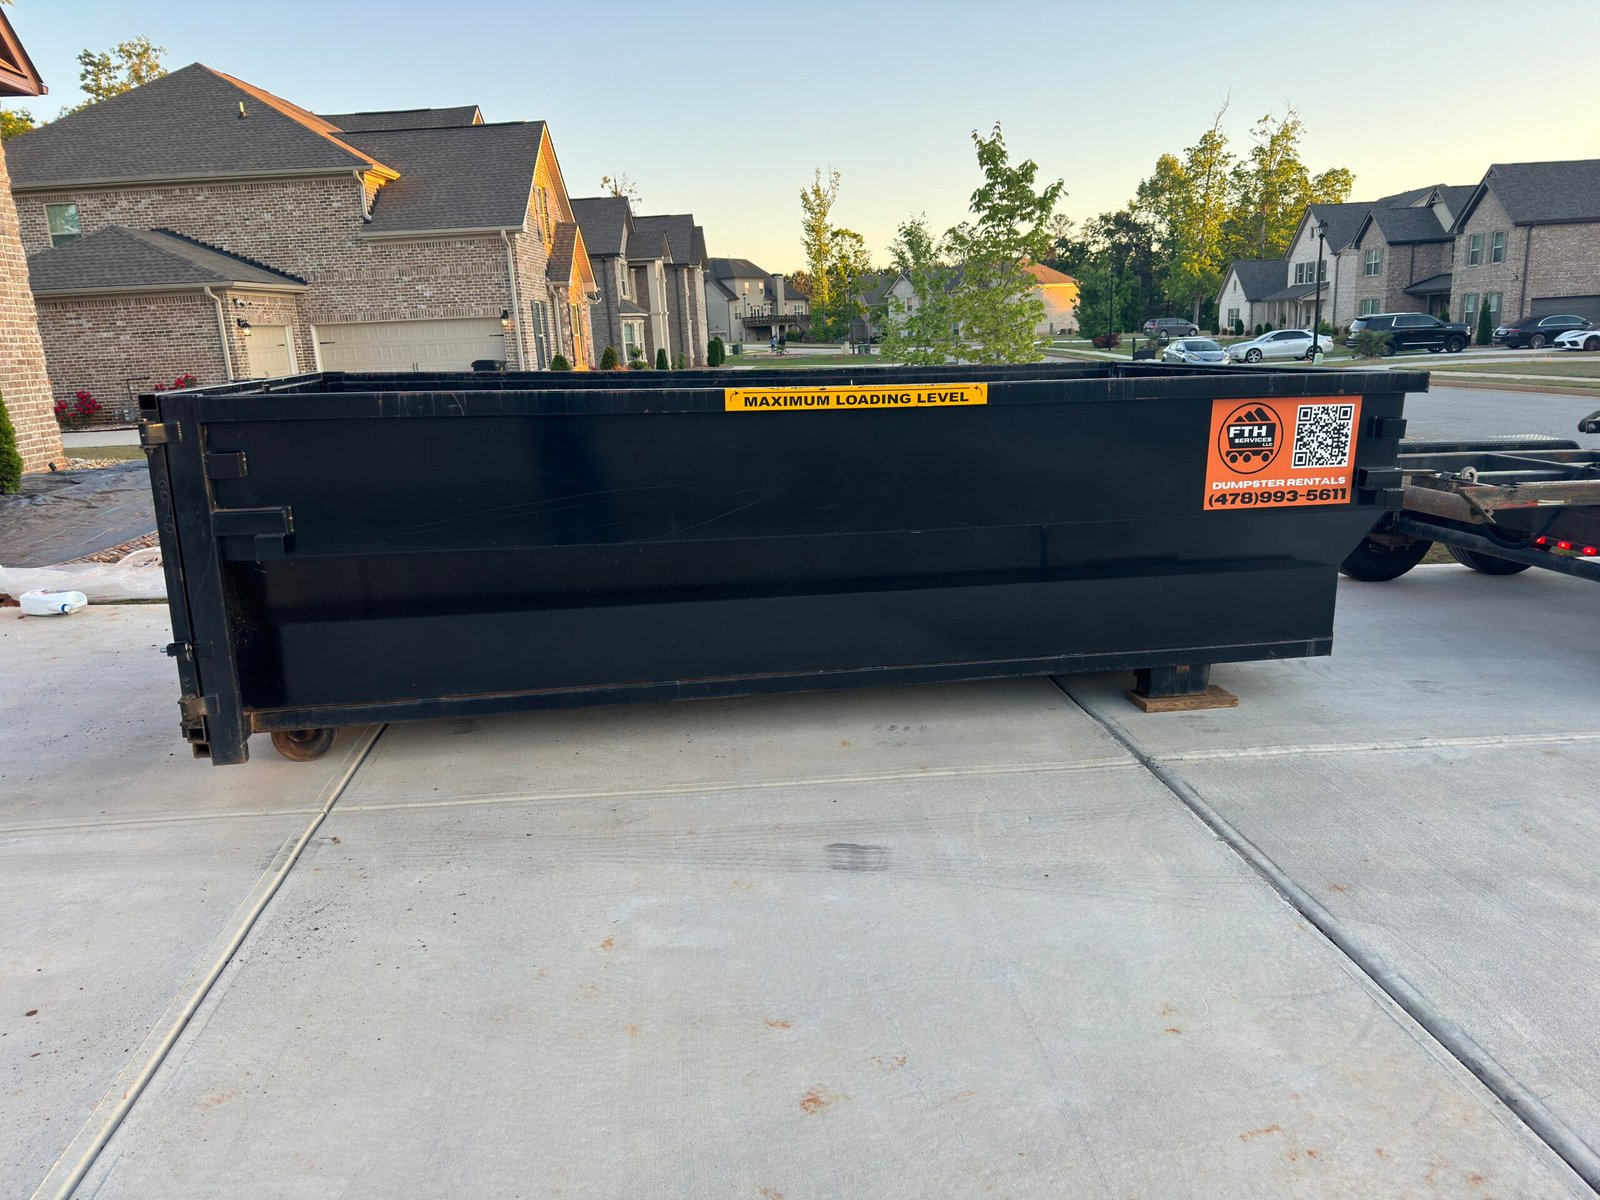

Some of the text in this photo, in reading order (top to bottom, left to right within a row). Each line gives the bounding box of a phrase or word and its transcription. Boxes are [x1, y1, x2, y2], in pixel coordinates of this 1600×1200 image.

[744, 391, 969, 407] MAXIMUM LOADING LEVEL
[1229, 425, 1267, 438] FTH
[1212, 477, 1346, 490] DUMPSTER RENTALS
[1209, 488, 1347, 507] (478)993-5611
